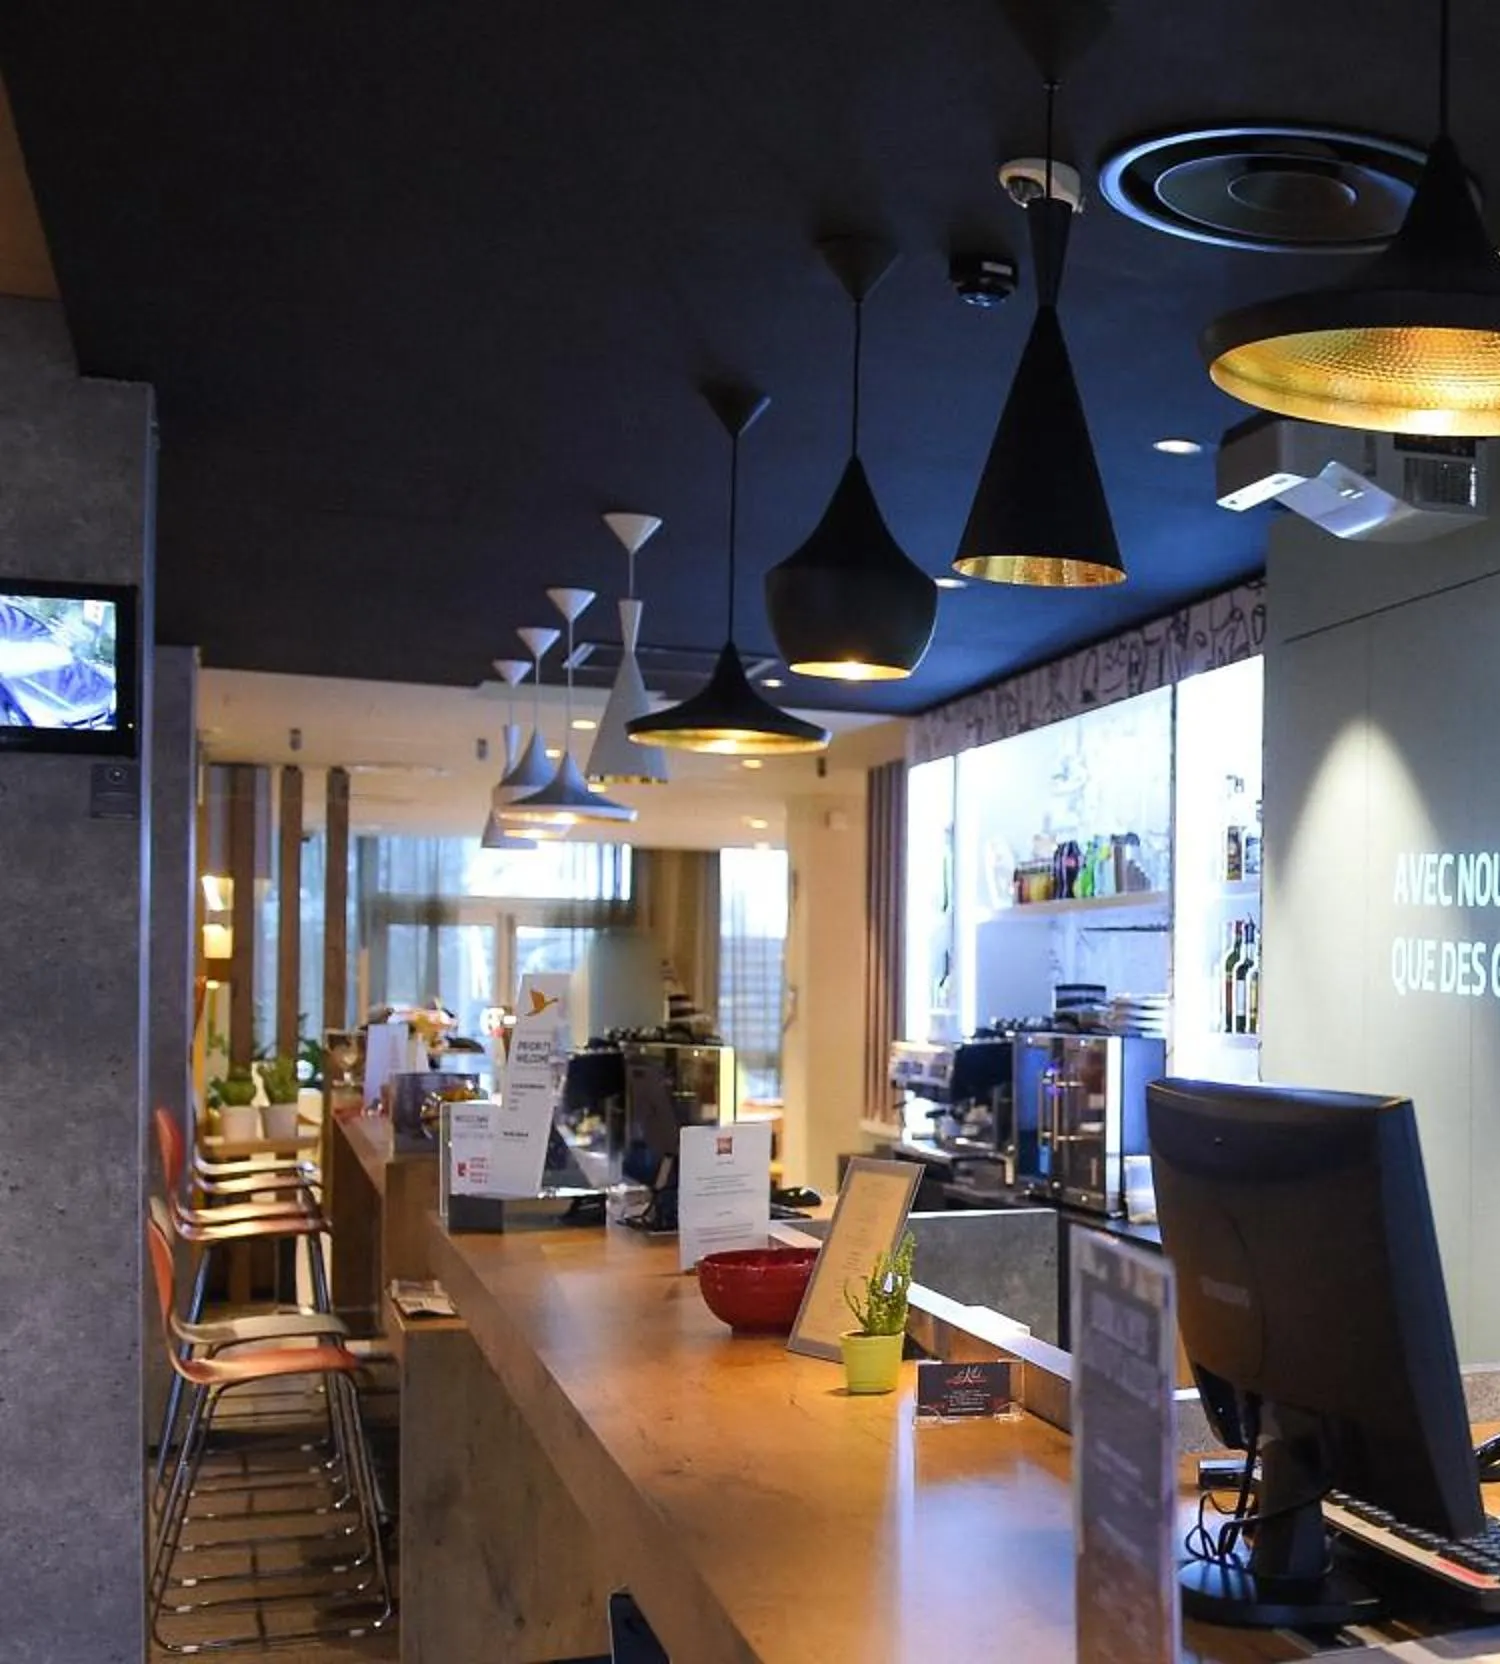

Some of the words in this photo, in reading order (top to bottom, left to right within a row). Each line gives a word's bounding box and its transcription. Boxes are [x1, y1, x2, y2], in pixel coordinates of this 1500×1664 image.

[1393, 851, 1454, 907] AVEC
[1391, 936, 1437, 996] QUE
[1439, 940, 1487, 996] DES
